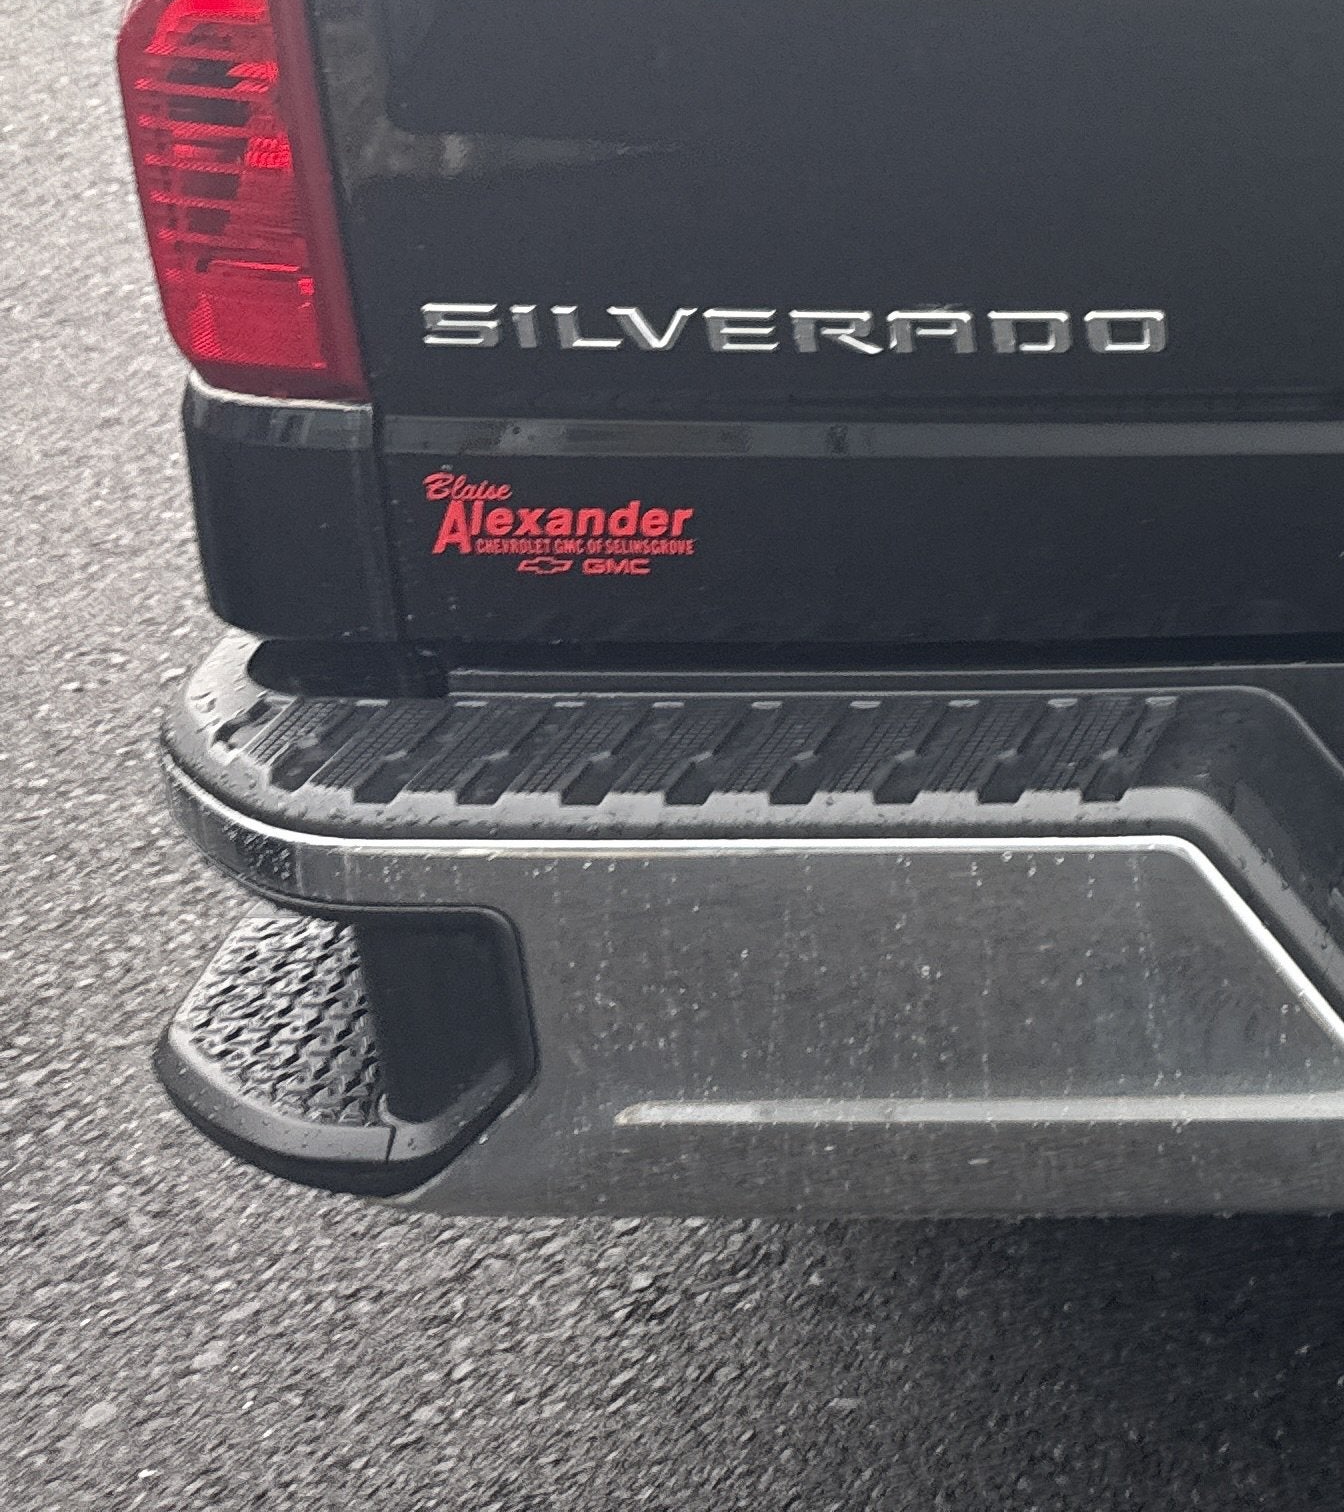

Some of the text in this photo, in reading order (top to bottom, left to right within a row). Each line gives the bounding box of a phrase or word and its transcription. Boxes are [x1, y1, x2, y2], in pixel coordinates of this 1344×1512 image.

[420, 302, 1167, 355] SILVERADO
[422, 471, 513, 501] Blaise
[432, 499, 694, 554] Alexander
[475, 538, 695, 556] CHEVROLET GMC OF SELINSGROVE
[581, 557, 651, 575] GMC
